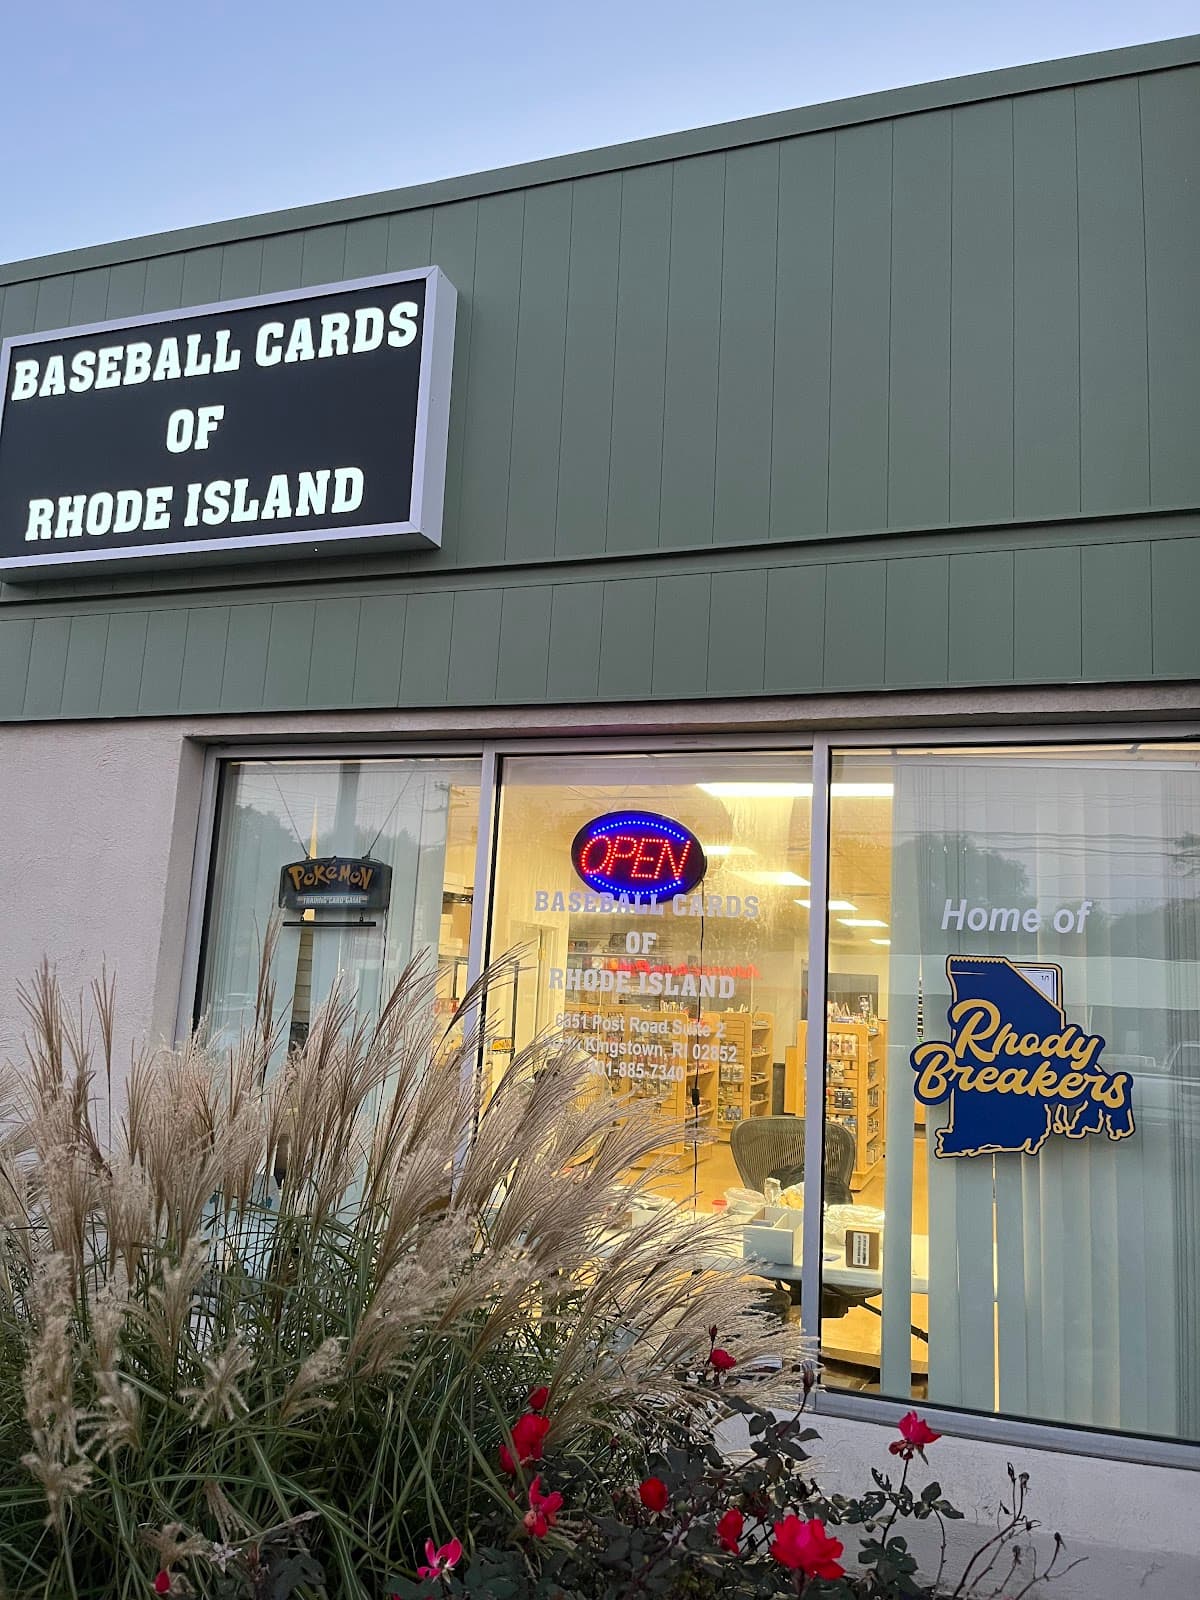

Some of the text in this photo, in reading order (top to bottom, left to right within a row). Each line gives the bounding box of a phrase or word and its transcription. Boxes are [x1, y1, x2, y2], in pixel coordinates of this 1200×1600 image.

[12, 301, 419, 401] BASEBALL CARDS
[165, 405, 225, 454] OF
[24, 466, 365, 542] RHODE ISLAND
[580, 834, 692, 881] OPEN
[534, 890, 759, 918] BASEBALL CARDS
[941, 898, 1093, 934] Home of
[625, 931, 657, 955] OF
[549, 967, 735, 999] RHODE ISLAND
[592, 1014, 625, 1032] Post
[629, 1016, 668, 1035] Road
[672, 1018, 711, 1038] Suite
[716, 1022, 727, 1039] 2
[951, 998, 1100, 1071] Rhody
[672, 1041, 688, 1060] RI
[692, 1044, 737, 1063] 02852
[914, 1043, 1127, 1109] Breakers
